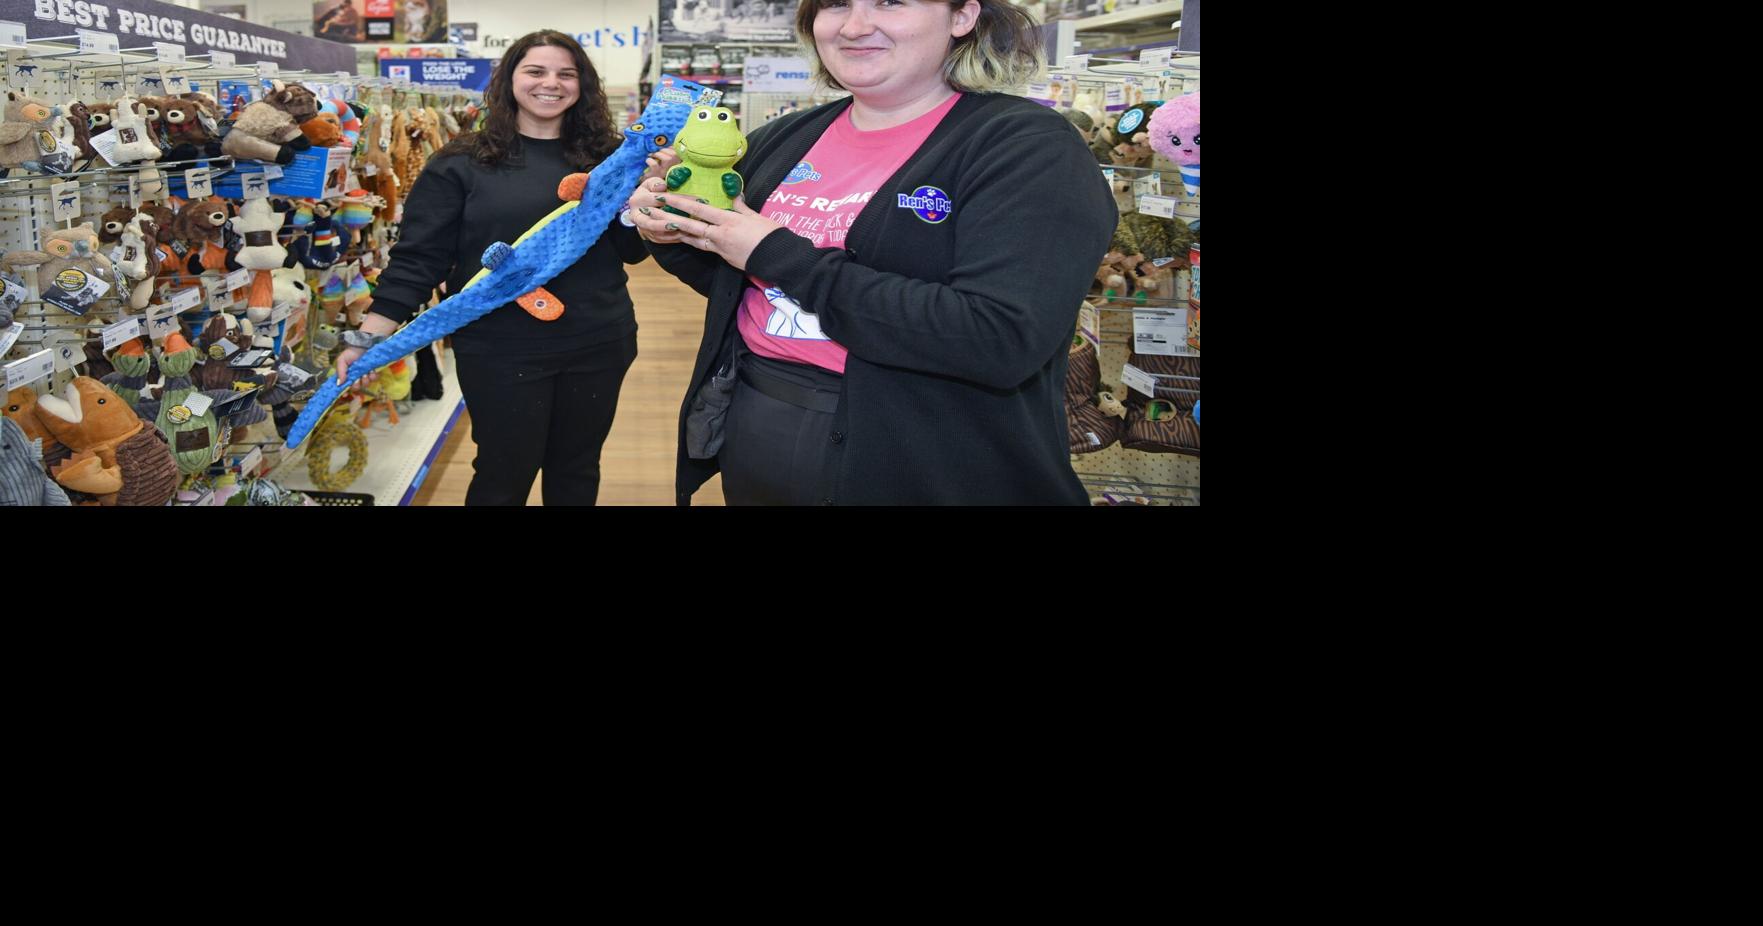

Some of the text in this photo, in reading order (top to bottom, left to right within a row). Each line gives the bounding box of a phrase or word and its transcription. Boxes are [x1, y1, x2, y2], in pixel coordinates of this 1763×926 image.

[34, 0, 287, 58] BEST PRICE GUARANTEE
[483, 34, 511, 48] for
[568, 27, 626, 48] et's
[422, 65, 476, 73] LOSE THE
[797, 168, 822, 182] Pets
[766, 189, 878, 212] EN'S REAR
[897, 193, 952, 213] Ren's Pe
[769, 211, 795, 226] JOIN
[796, 216, 824, 231] THE
[823, 212, 846, 231] CK
[827, 229, 849, 243] TODA
